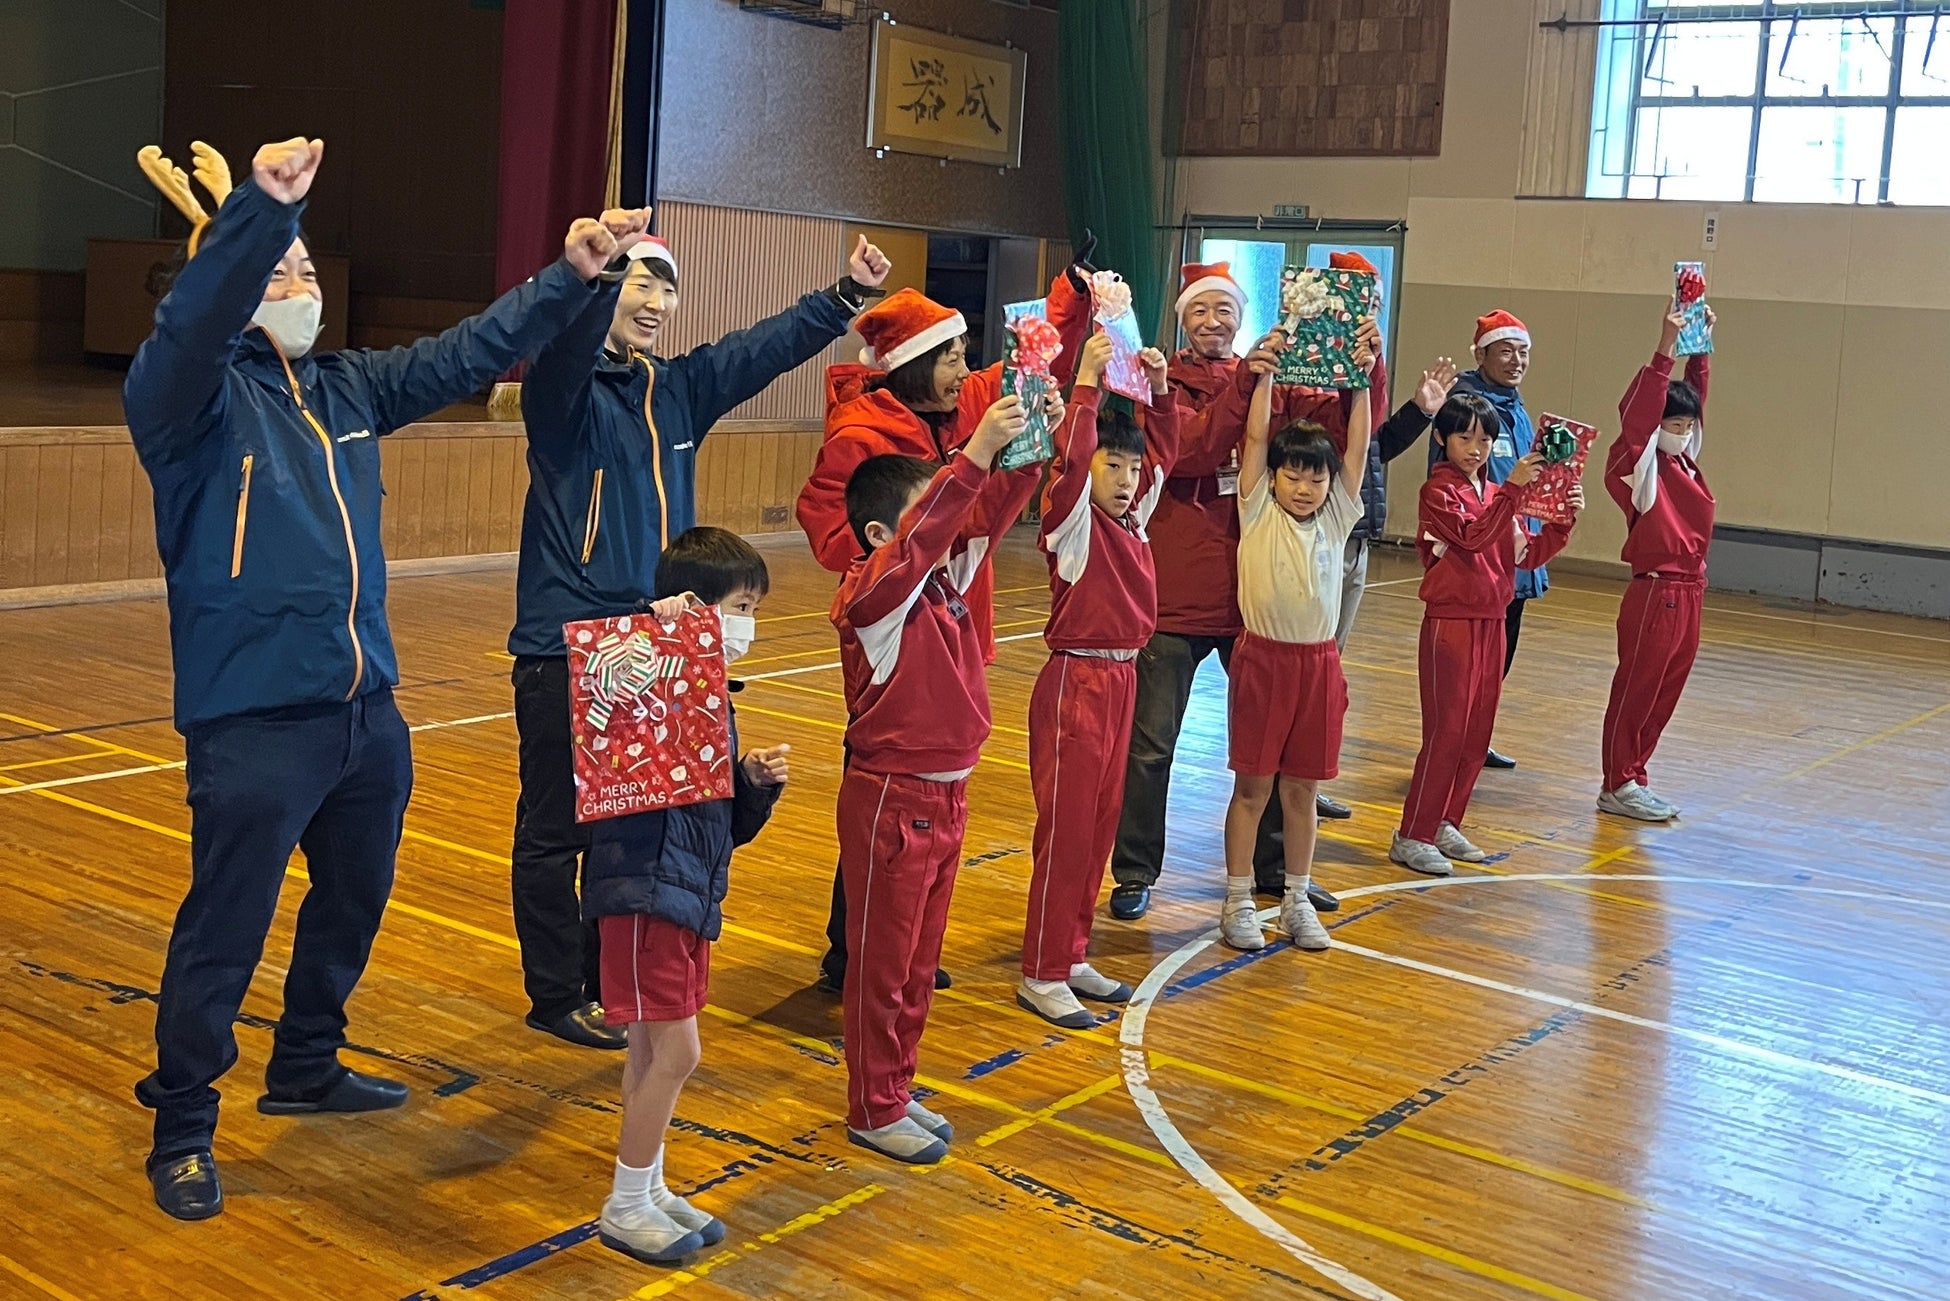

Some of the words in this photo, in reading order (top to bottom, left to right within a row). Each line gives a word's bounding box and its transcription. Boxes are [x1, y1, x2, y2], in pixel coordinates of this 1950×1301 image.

[1287, 366, 1319, 375] MERRY
[1276, 374, 1329, 385] CHRISTMAS
[600, 780, 648, 798] MERRY
[582, 791, 666, 815] CHRISTMAS
